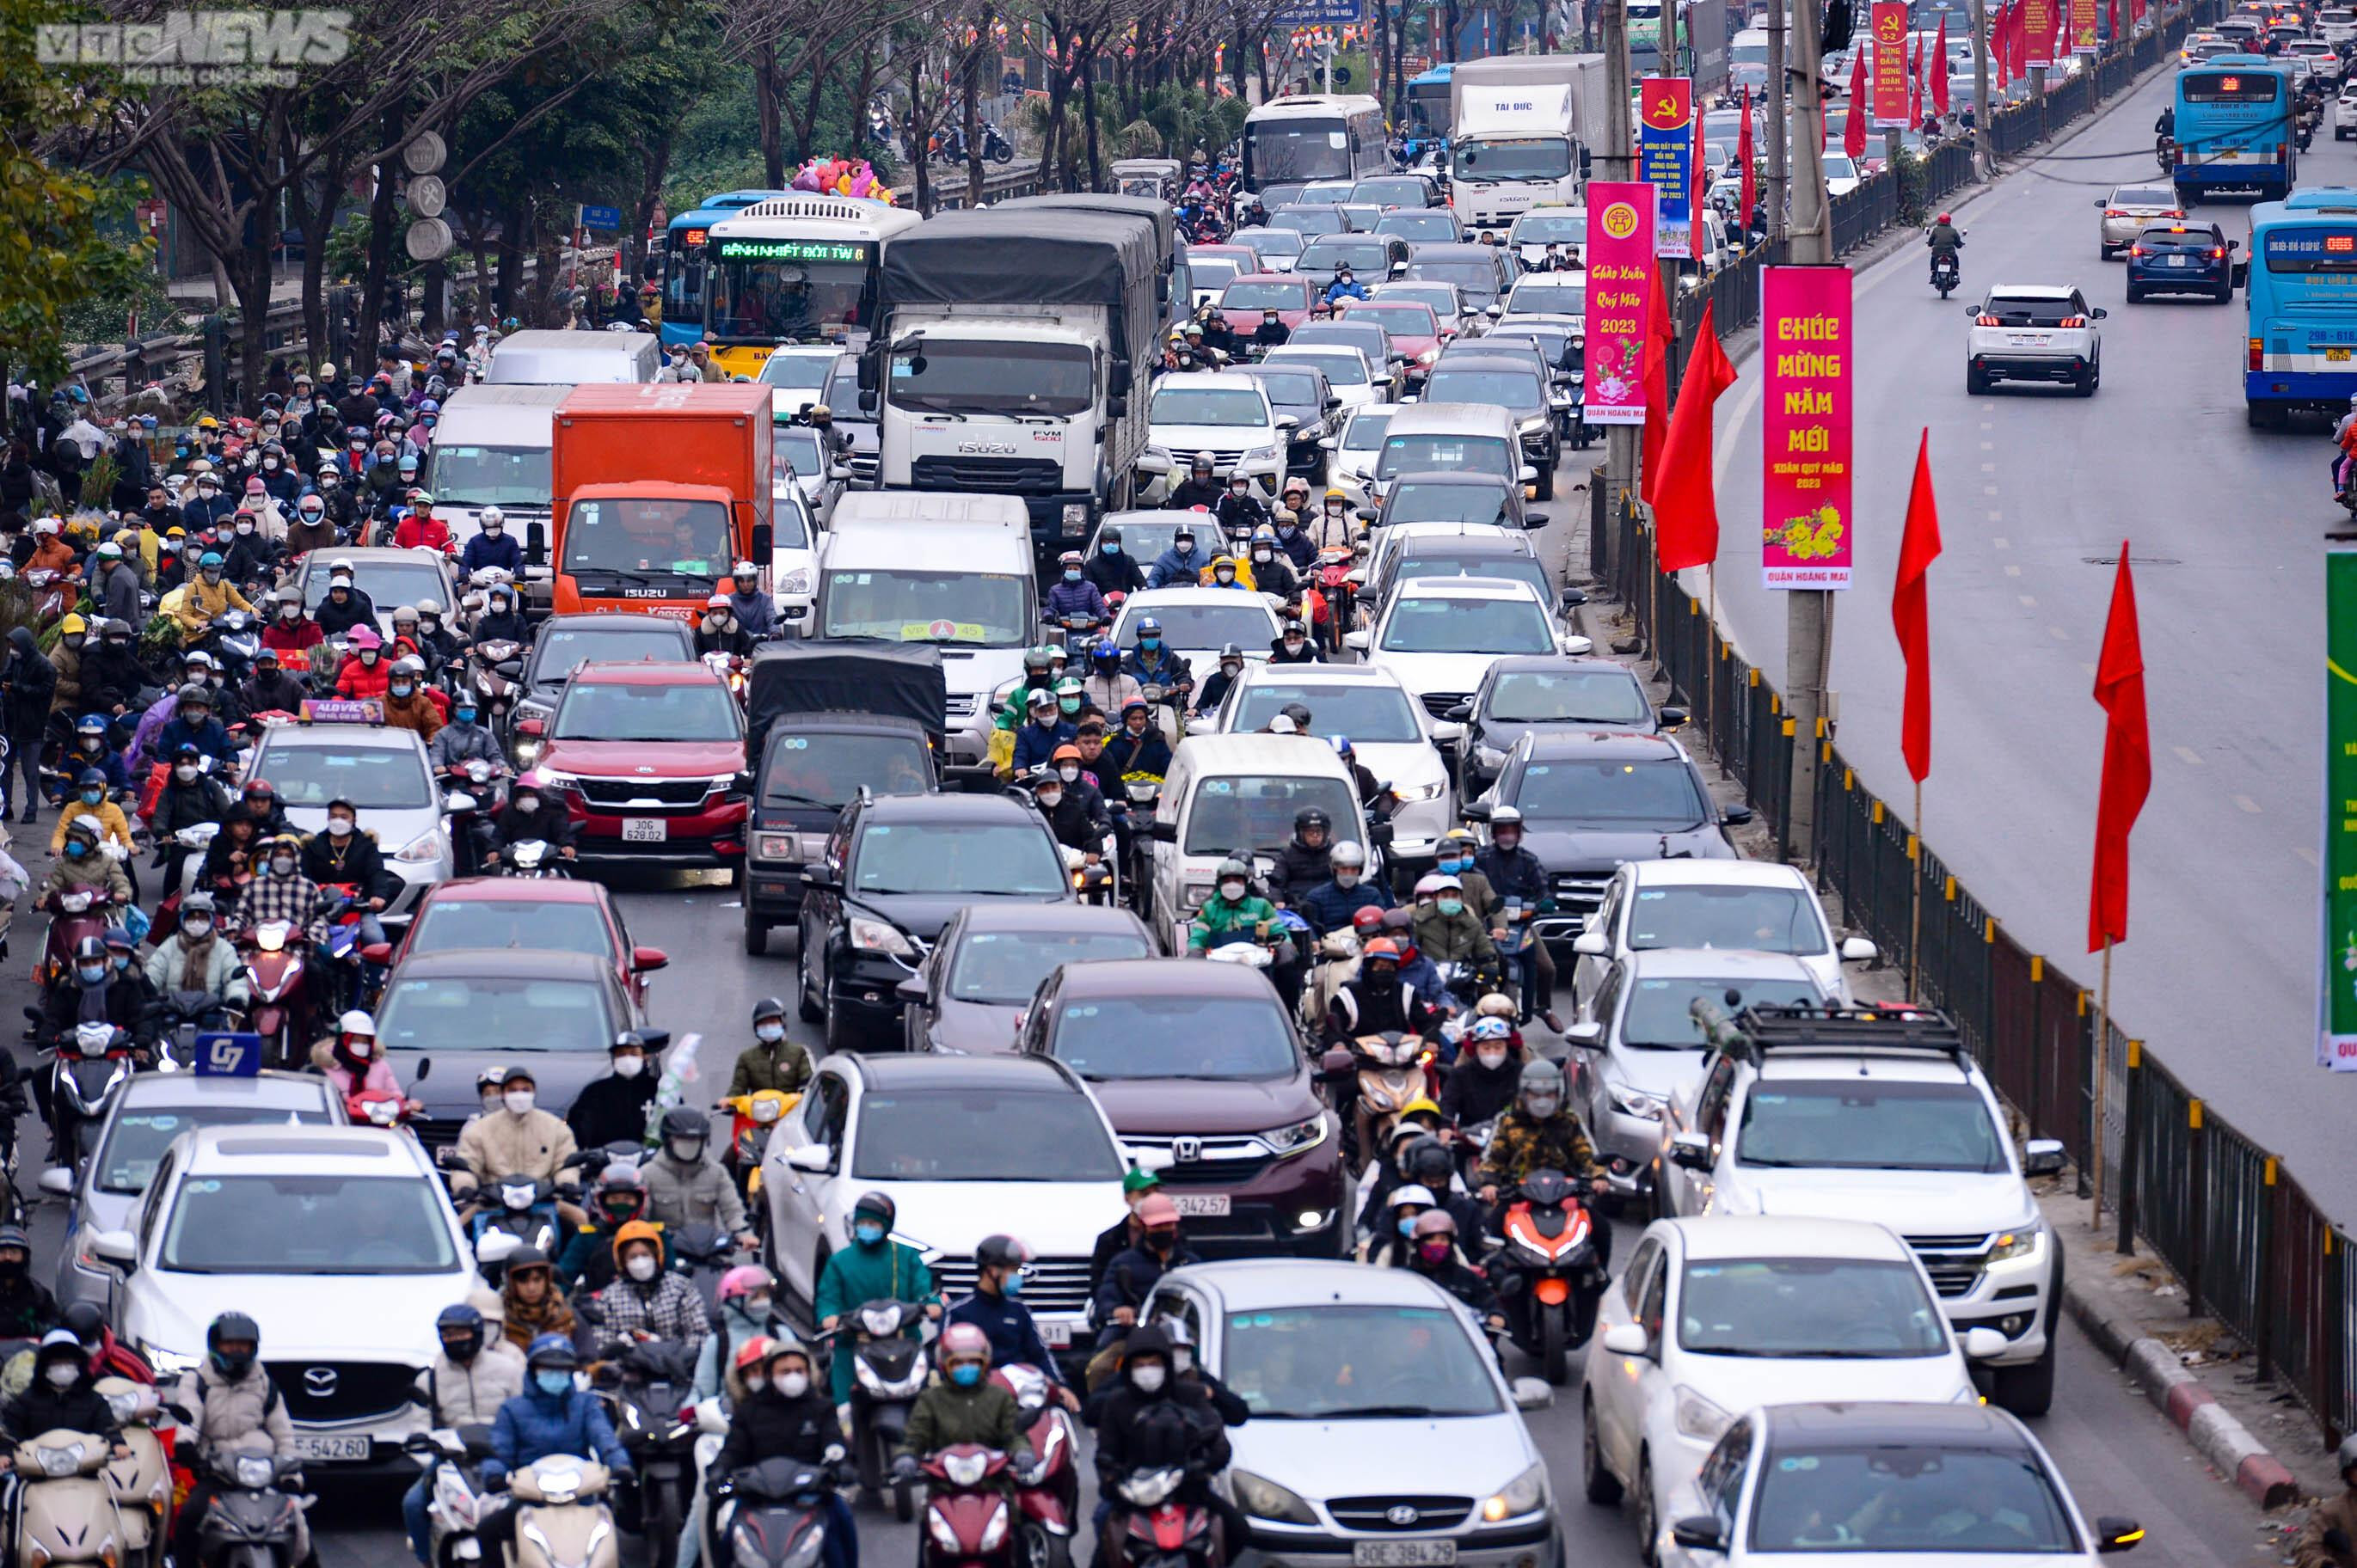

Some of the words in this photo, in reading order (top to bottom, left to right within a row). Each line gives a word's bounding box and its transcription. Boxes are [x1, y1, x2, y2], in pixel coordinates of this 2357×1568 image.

[1600, 319, 1636, 334] 2023
[1778, 313, 1839, 340] CHÚC
[1777, 349, 1841, 377] MỪNG
[1784, 387, 1833, 414] NĂM
[1788, 424, 1829, 451] MỚI
[958, 440, 1017, 454] ISUZU
[1796, 478, 1820, 488] 2023
[624, 589, 667, 597] ISUZU
[961, 625, 978, 636] 45
